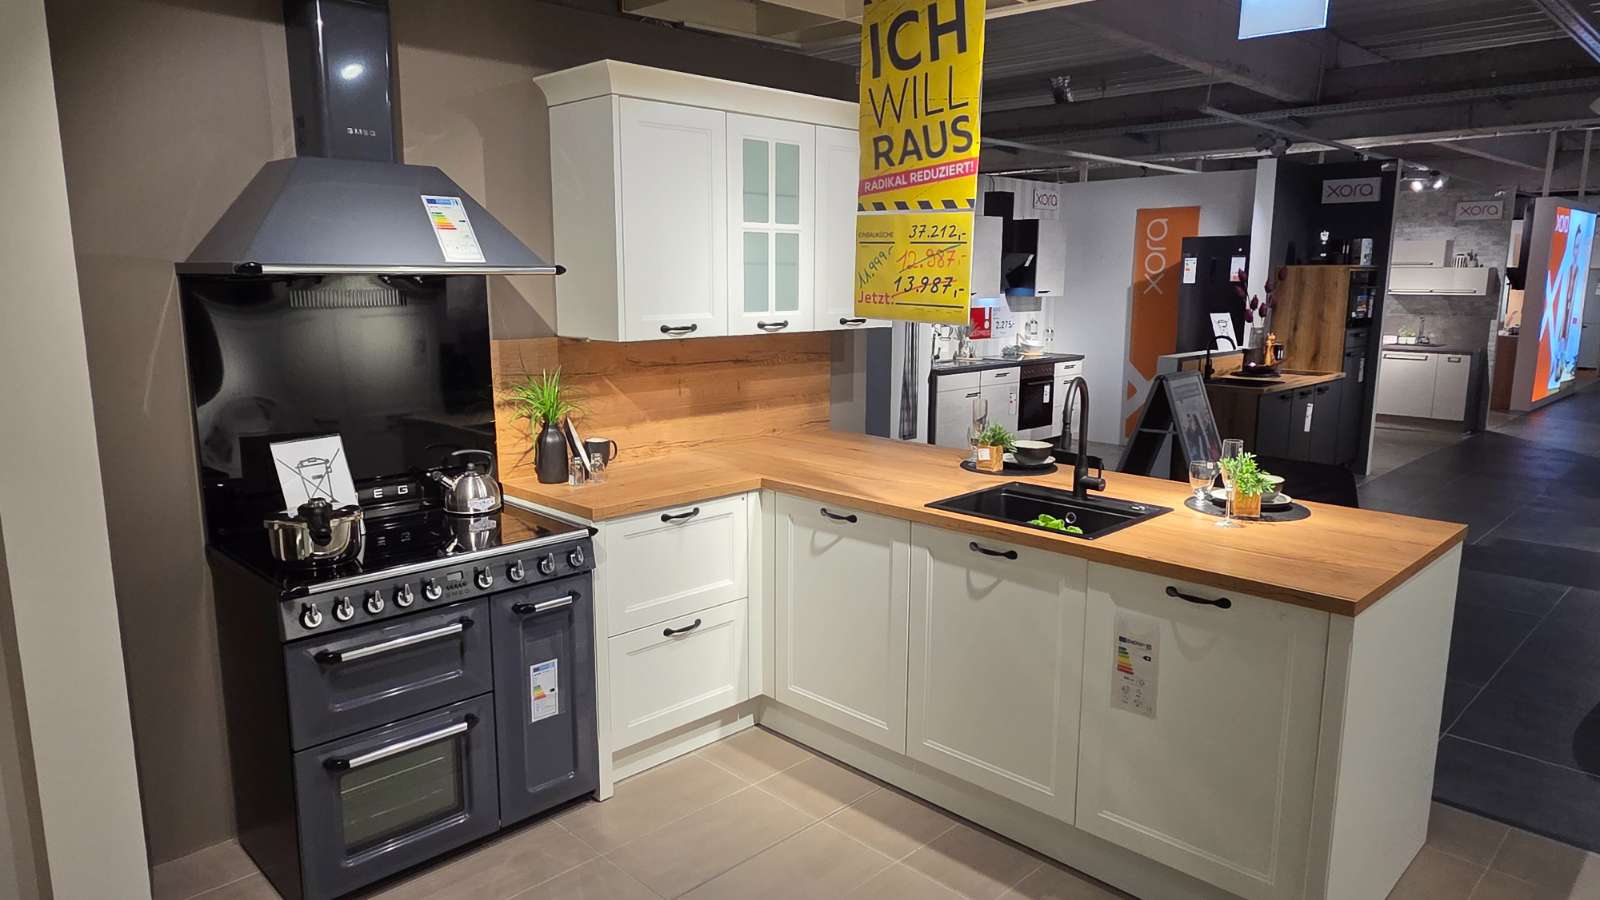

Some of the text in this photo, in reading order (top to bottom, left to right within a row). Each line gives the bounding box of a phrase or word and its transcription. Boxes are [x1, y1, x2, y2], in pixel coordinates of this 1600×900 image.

[869, 0, 967, 79] ICH
[868, 65, 969, 128] WILL
[873, 115, 973, 170] RAUS
[864, 160, 975, 193] RADIKAL REDUZIERT!
[1035, 191, 1058, 207] xora
[1326, 183, 1374, 198] xora
[1459, 204, 1499, 217] xora
[1143, 218, 1169, 295] xora
[857, 291, 895, 305] Jetzt:
[373, 484, 409, 499] EG
